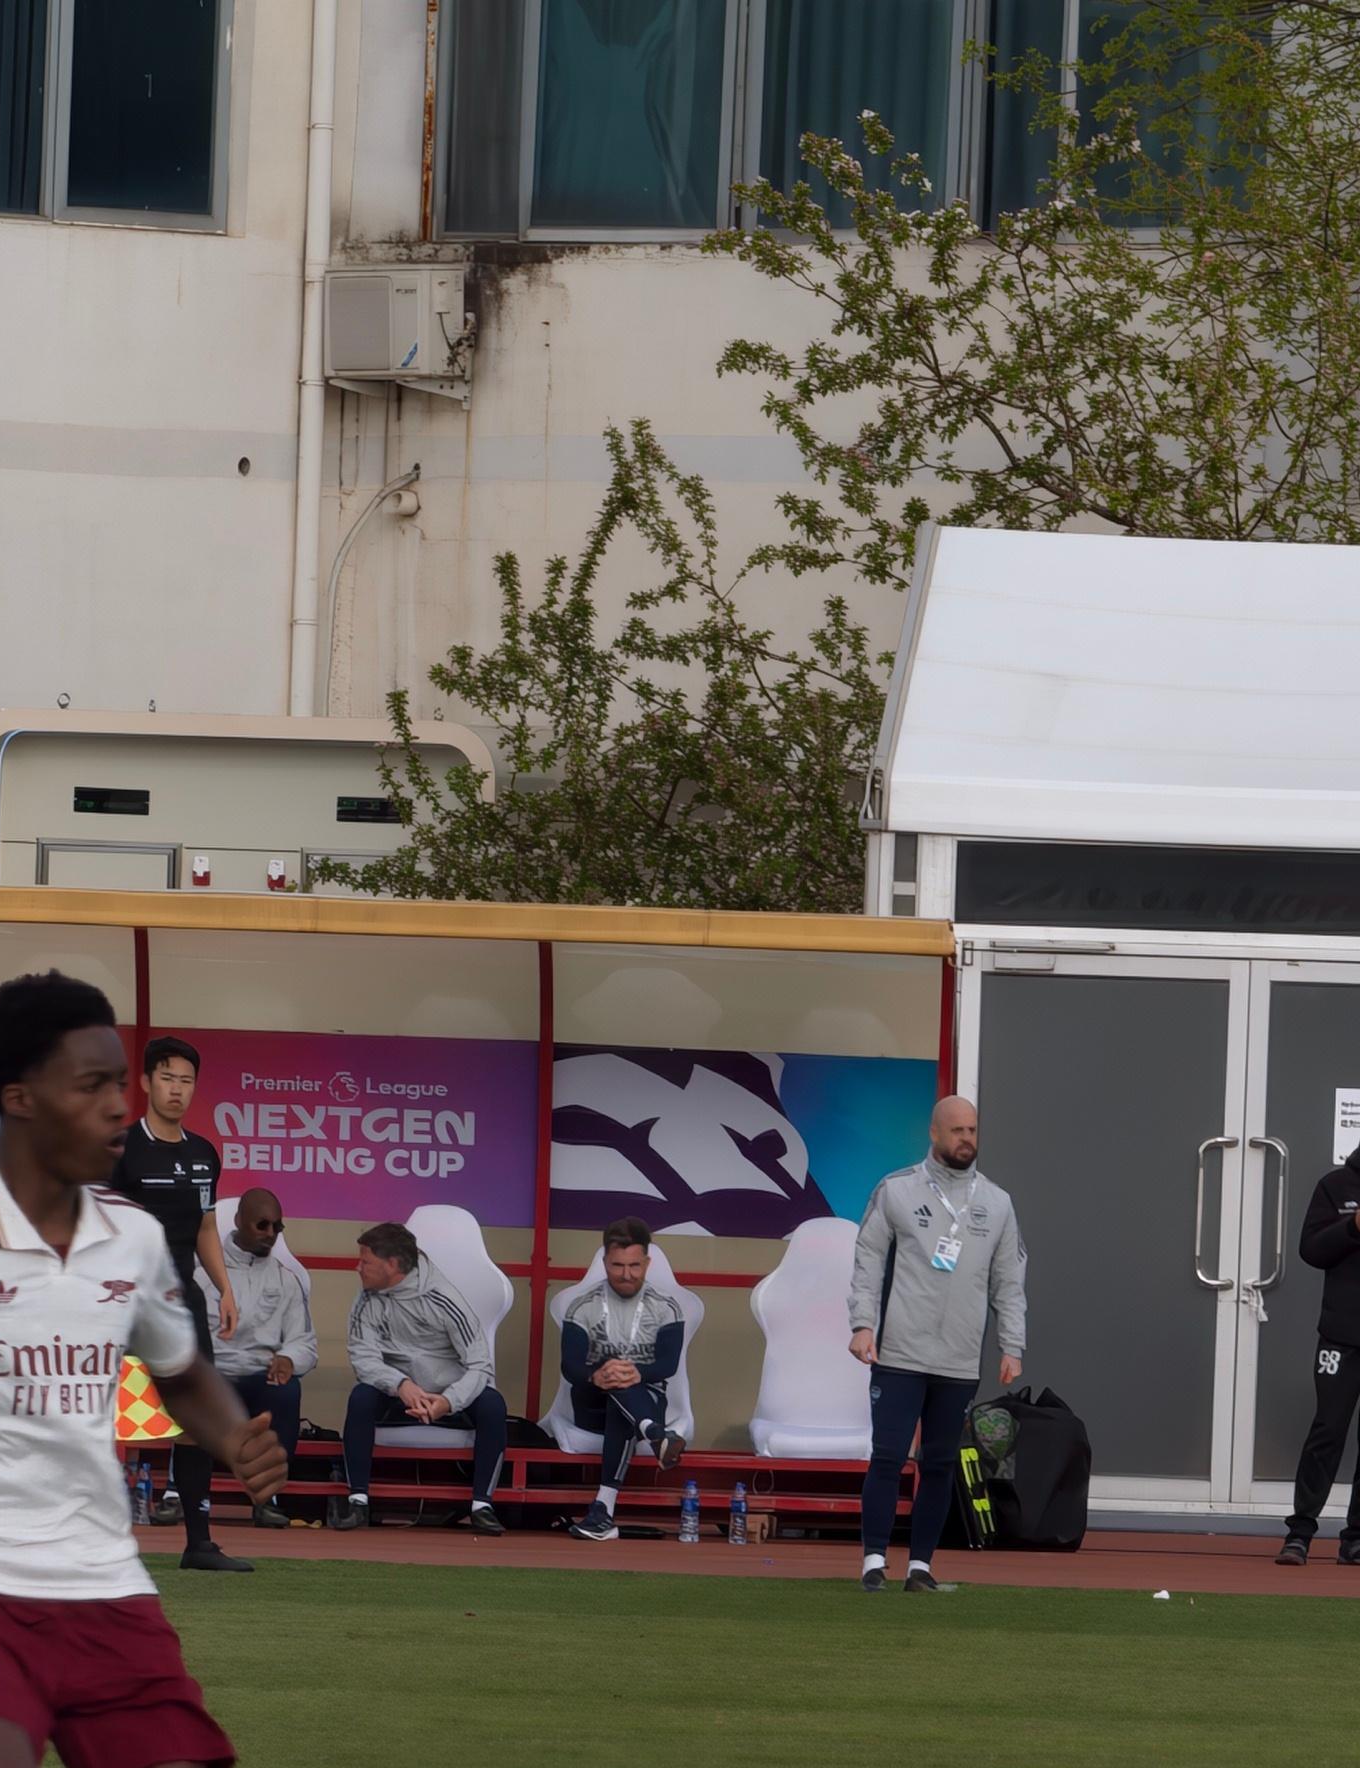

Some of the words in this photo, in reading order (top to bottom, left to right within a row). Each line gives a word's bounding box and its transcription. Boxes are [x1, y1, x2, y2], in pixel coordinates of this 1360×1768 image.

[241, 1072, 323, 1092] Premier
[365, 1077, 448, 1099] League
[214, 1102, 476, 1146] NEXTGEN
[222, 1143, 376, 1174] BEIJING
[384, 1149, 465, 1178] CUP
[11, 1385, 50, 1416] FLY
